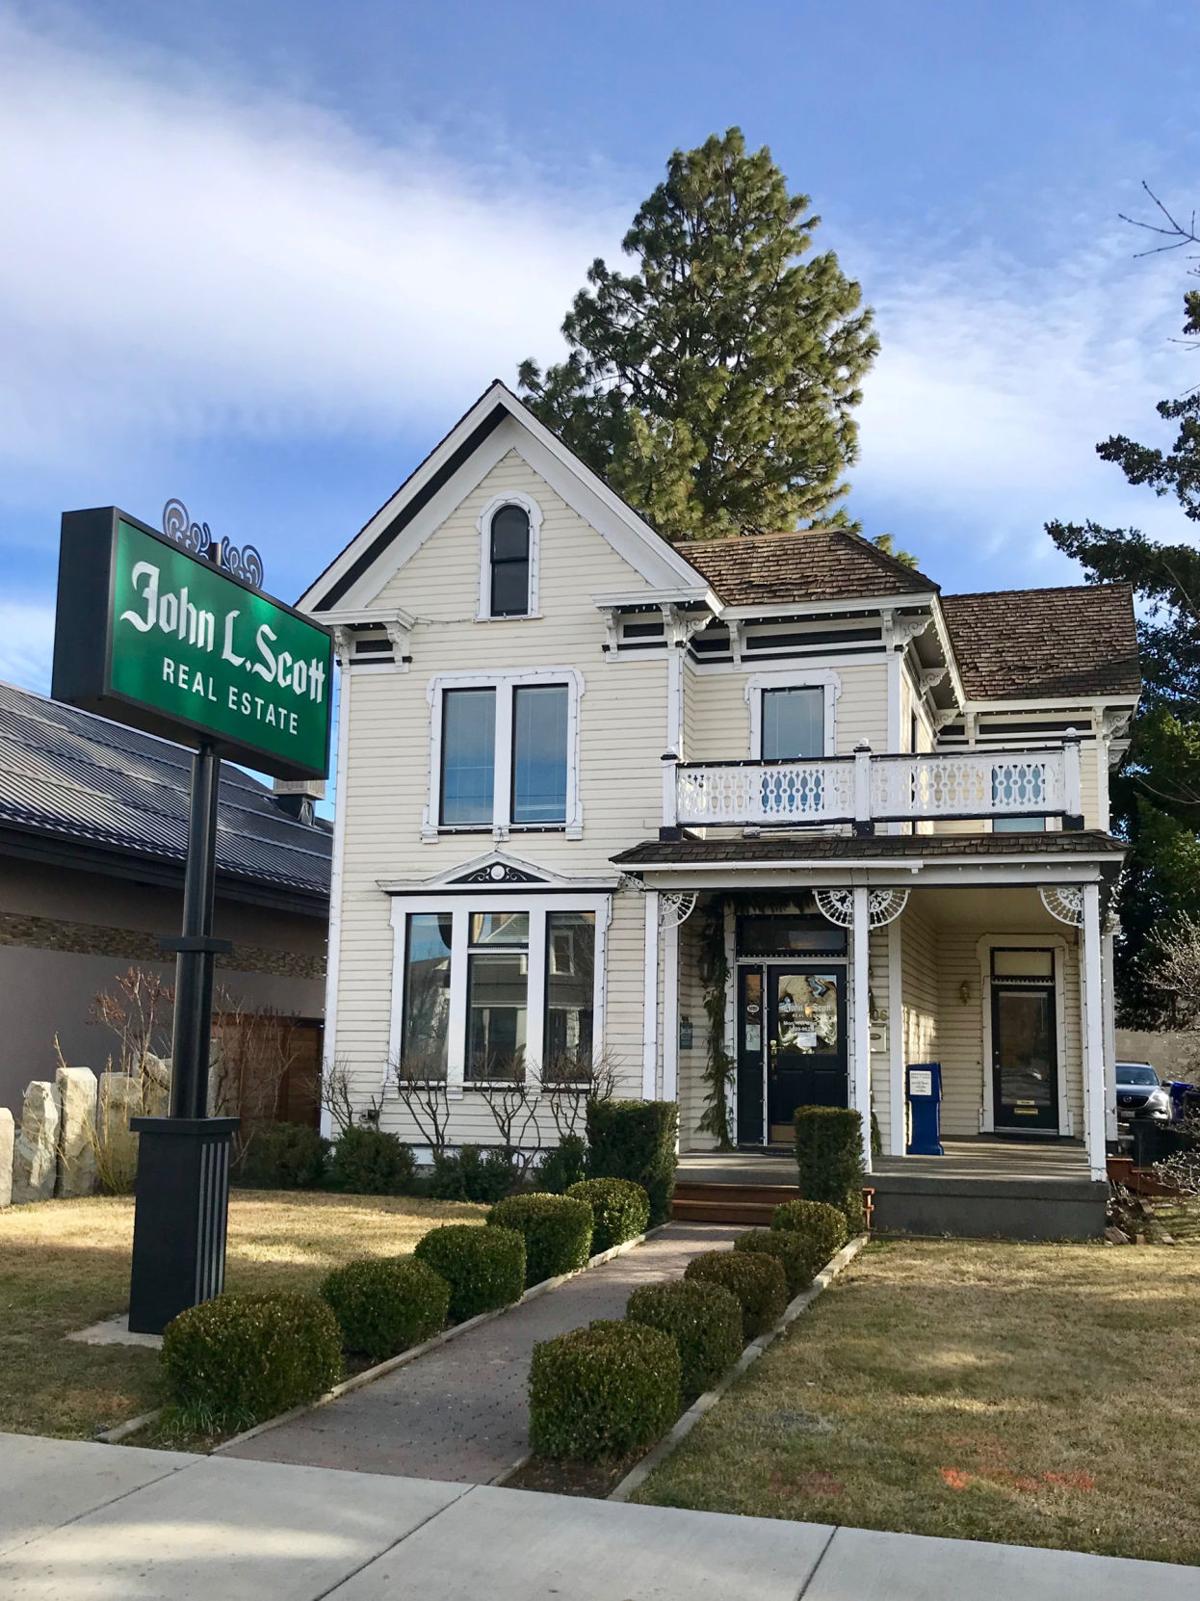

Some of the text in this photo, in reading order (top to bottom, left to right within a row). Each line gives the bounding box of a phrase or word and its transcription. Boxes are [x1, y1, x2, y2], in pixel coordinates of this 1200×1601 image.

[120, 560, 215, 654] John
[163, 657, 299, 735] REAL ESTATE
